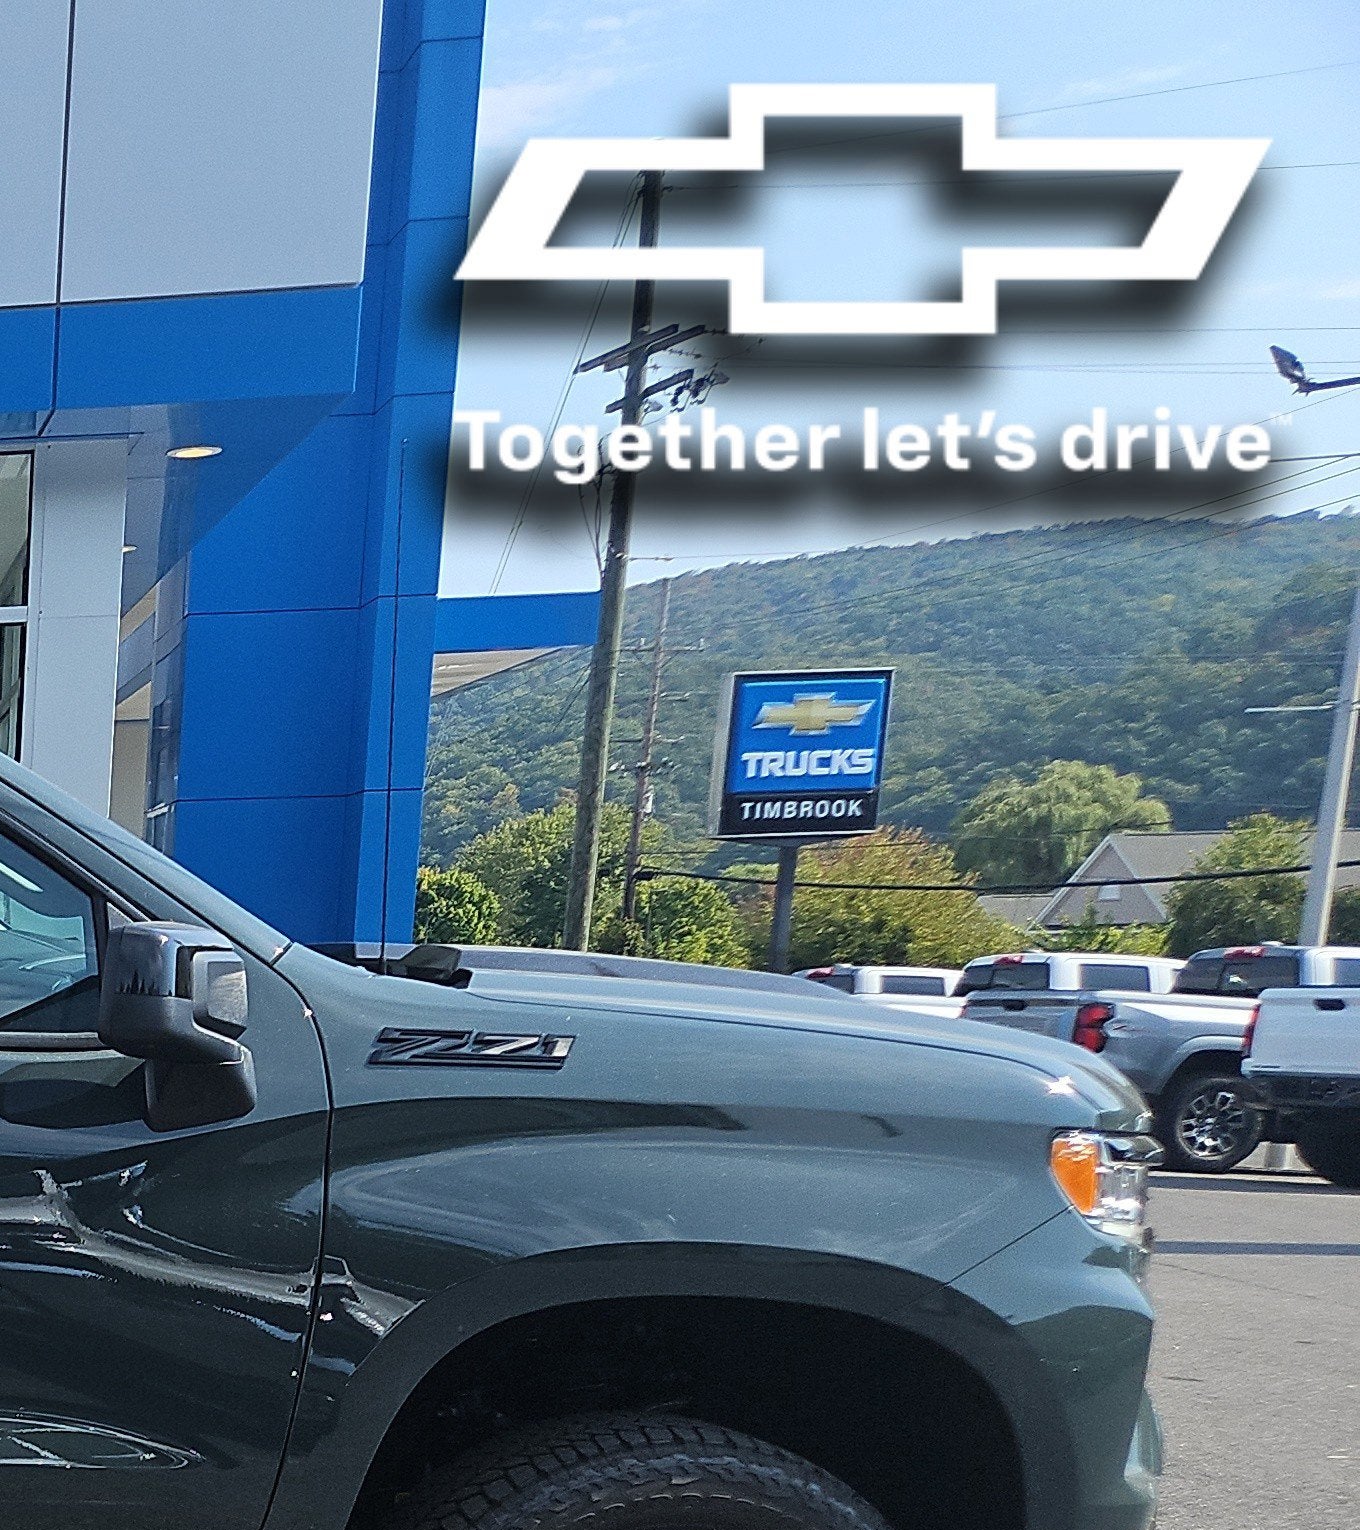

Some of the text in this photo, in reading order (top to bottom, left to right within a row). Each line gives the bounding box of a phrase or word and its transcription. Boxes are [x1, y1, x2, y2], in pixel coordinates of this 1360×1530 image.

[741, 749, 876, 778] TRUCKS
[741, 799, 864, 820] TIMBROOK
[365, 1026, 578, 1070] Z71
